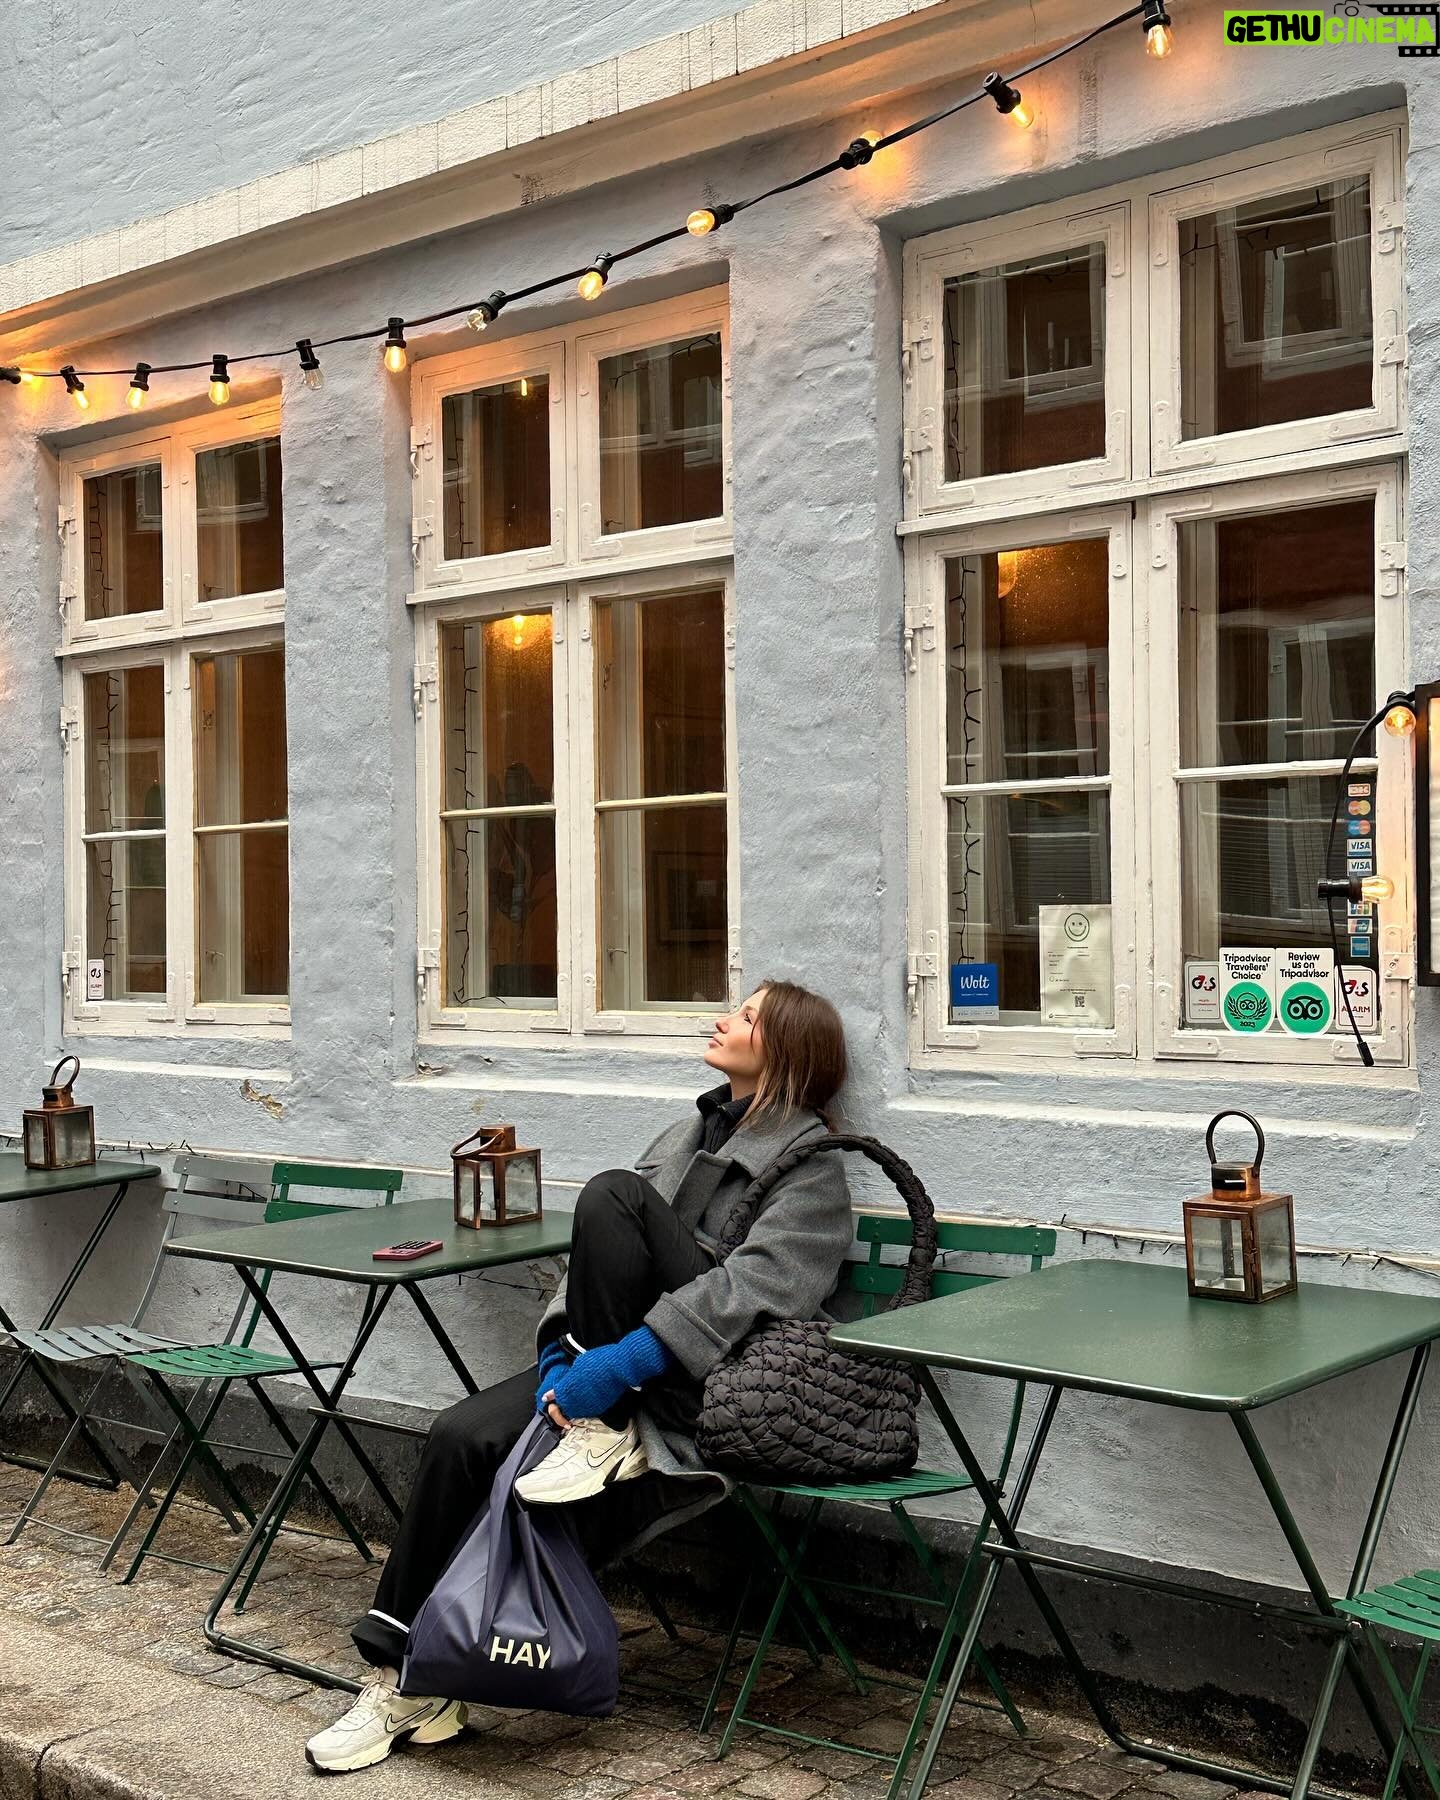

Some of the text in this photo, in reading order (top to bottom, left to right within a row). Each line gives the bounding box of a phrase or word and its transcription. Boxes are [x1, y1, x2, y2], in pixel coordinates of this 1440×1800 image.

[1351, 841, 1370, 850] VISA
[1351, 861, 1371, 870] VISA
[1223, 953, 1271, 963] Tripadvisor
[1288, 952, 1320, 961] Review
[1231, 972, 1262, 980] Choice
[1280, 969, 1329, 979] Tripadvisor
[960, 974, 990, 989] Wolt
[1341, 1005, 1371, 1013] AARM
[489, 1635, 551, 1670] HAY
